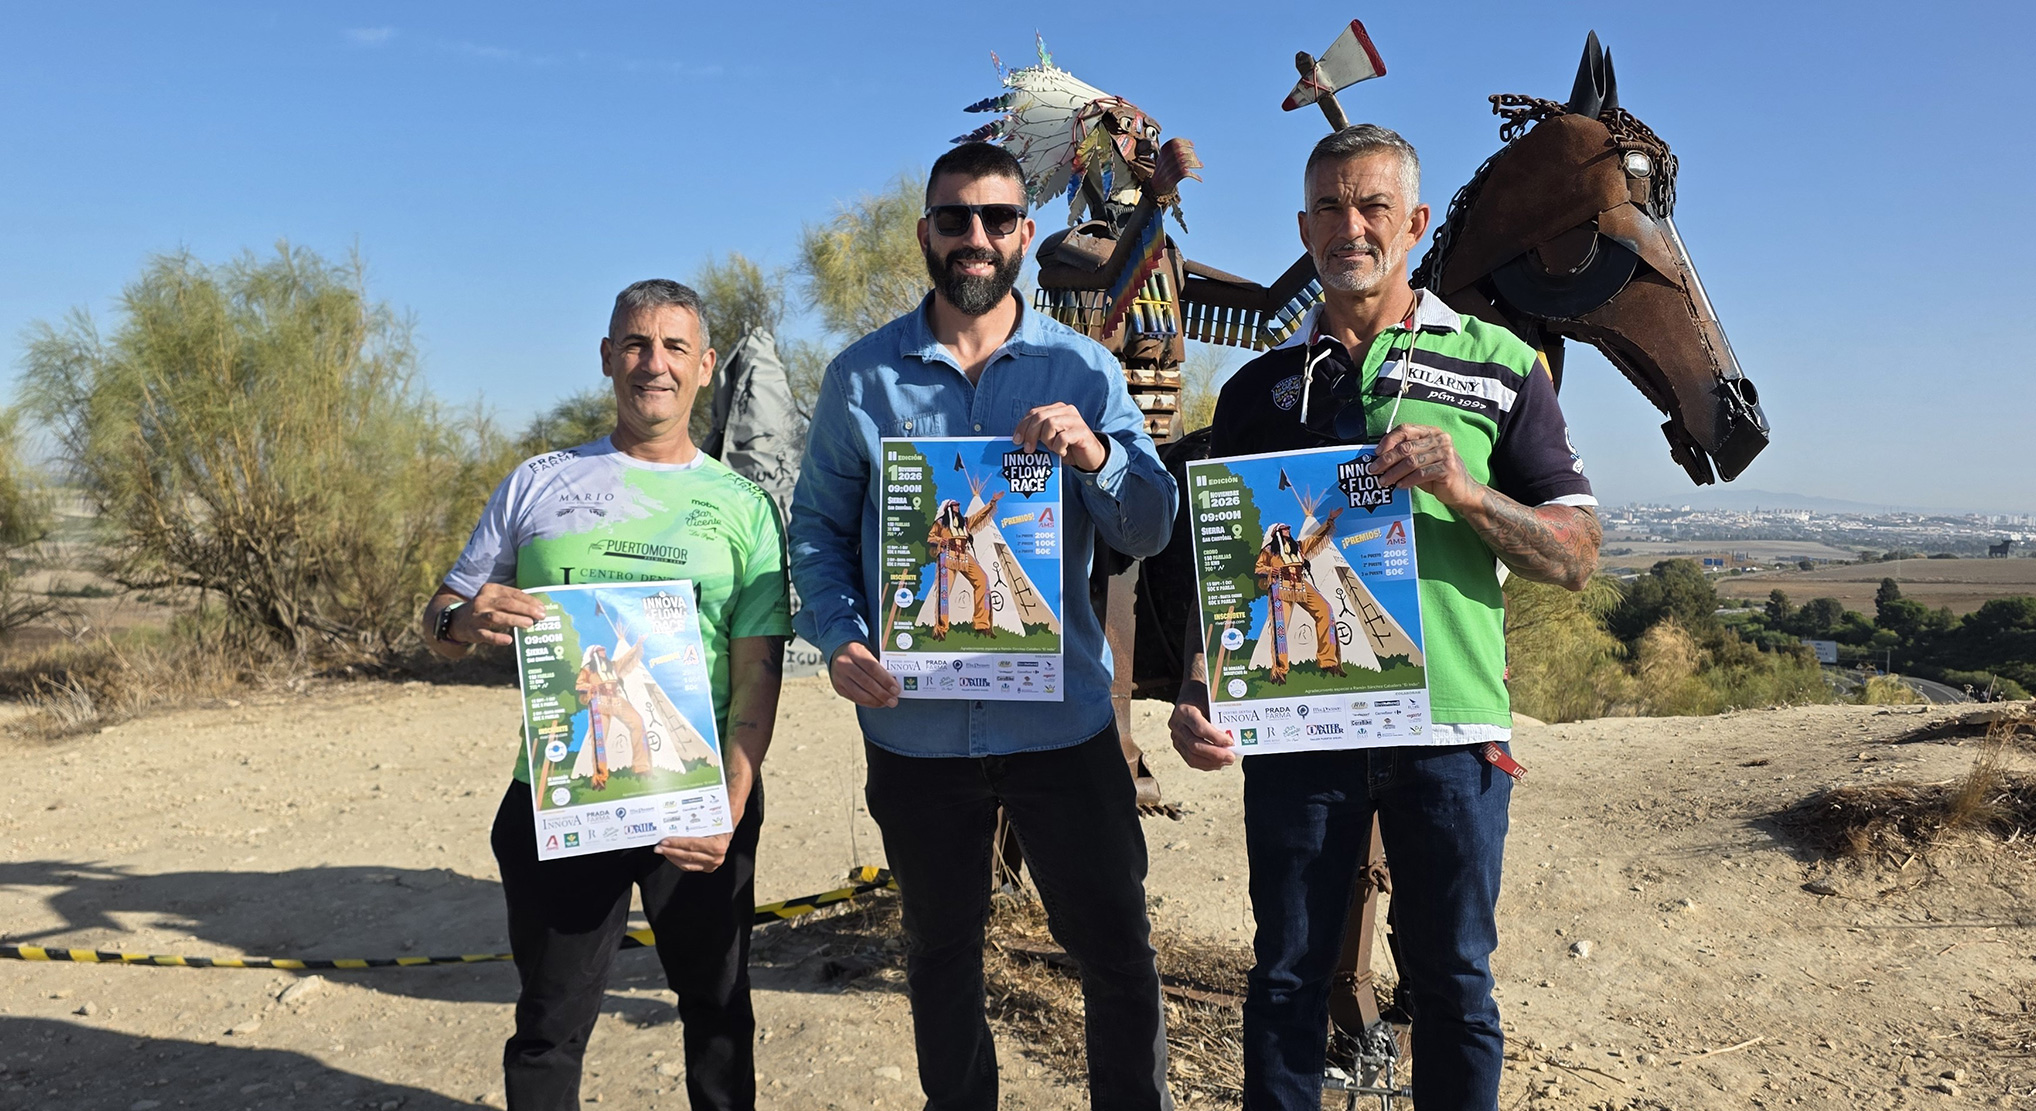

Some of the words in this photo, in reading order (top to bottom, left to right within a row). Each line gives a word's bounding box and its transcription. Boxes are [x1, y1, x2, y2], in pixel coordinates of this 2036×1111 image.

[1408, 367, 1480, 392] KILARNY
[1458, 399, 1487, 410] 1997
[1004, 453, 1052, 467] INNOVA
[888, 465, 898, 481] 1
[898, 472, 922, 481] 2026
[1011, 466, 1047, 479] FLOW
[1339, 461, 1373, 480] INNO
[1011, 478, 1045, 492] RACE
[1208, 476, 1239, 486] EDICIÓN
[888, 484, 922, 493] 09:00H
[559, 493, 614, 502] MARIO
[1198, 490, 1210, 509] 1
[1210, 496, 1240, 508] 2026
[1350, 488, 1391, 507] RACE
[685, 518, 721, 527] Vicente
[1200, 510, 1242, 523] 09:00H
[1201, 526, 1225, 536] SIERRA
[1341, 526, 1382, 550] ¡PREMIOS!
[1386, 538, 1407, 546] AMS
[607, 540, 688, 560] PUERTOMOTOR
[1383, 549, 1408, 558] 200€
[1384, 558, 1409, 567] 100€
[580, 568, 633, 580] CENTRO
[1385, 567, 1404, 576] 50€
[642, 596, 687, 610] INNOVA
[650, 608, 683, 620] FLOW
[524, 633, 563, 645] 09:00H
[886, 659, 921, 671] INNOVA
[1218, 709, 1260, 724] INNOVA
[1265, 711, 1292, 719] FARMA
[543, 815, 582, 830] INNOVA
